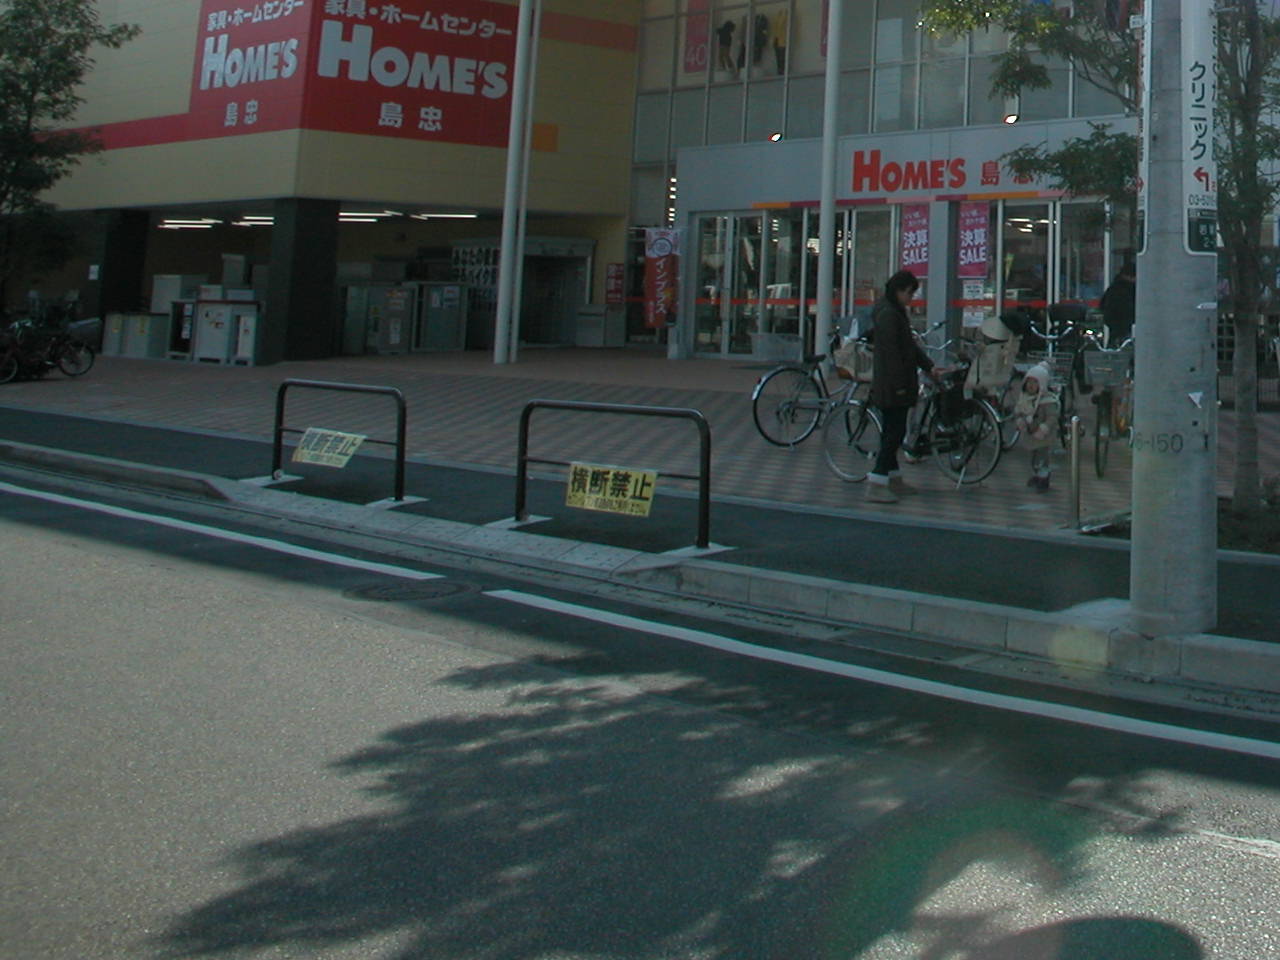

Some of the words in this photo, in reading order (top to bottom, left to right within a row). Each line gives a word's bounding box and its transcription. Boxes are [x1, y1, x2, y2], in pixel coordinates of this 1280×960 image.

[199, 33, 299, 90] HOME'S
[317, 20, 509, 100] HOME'S
[224, 100, 259, 127] 島忠
[378, 101, 443, 131] 島忠
[1189, 60, 1208, 161] クリニック
[852, 149, 967, 193] HOME'S
[903, 229, 928, 248] 決算
[961, 228, 987, 246] 決算
[903, 248, 928, 265] SALE
[960, 247, 987, 265] SALE
[572, 466, 651, 502] 横断禁止
